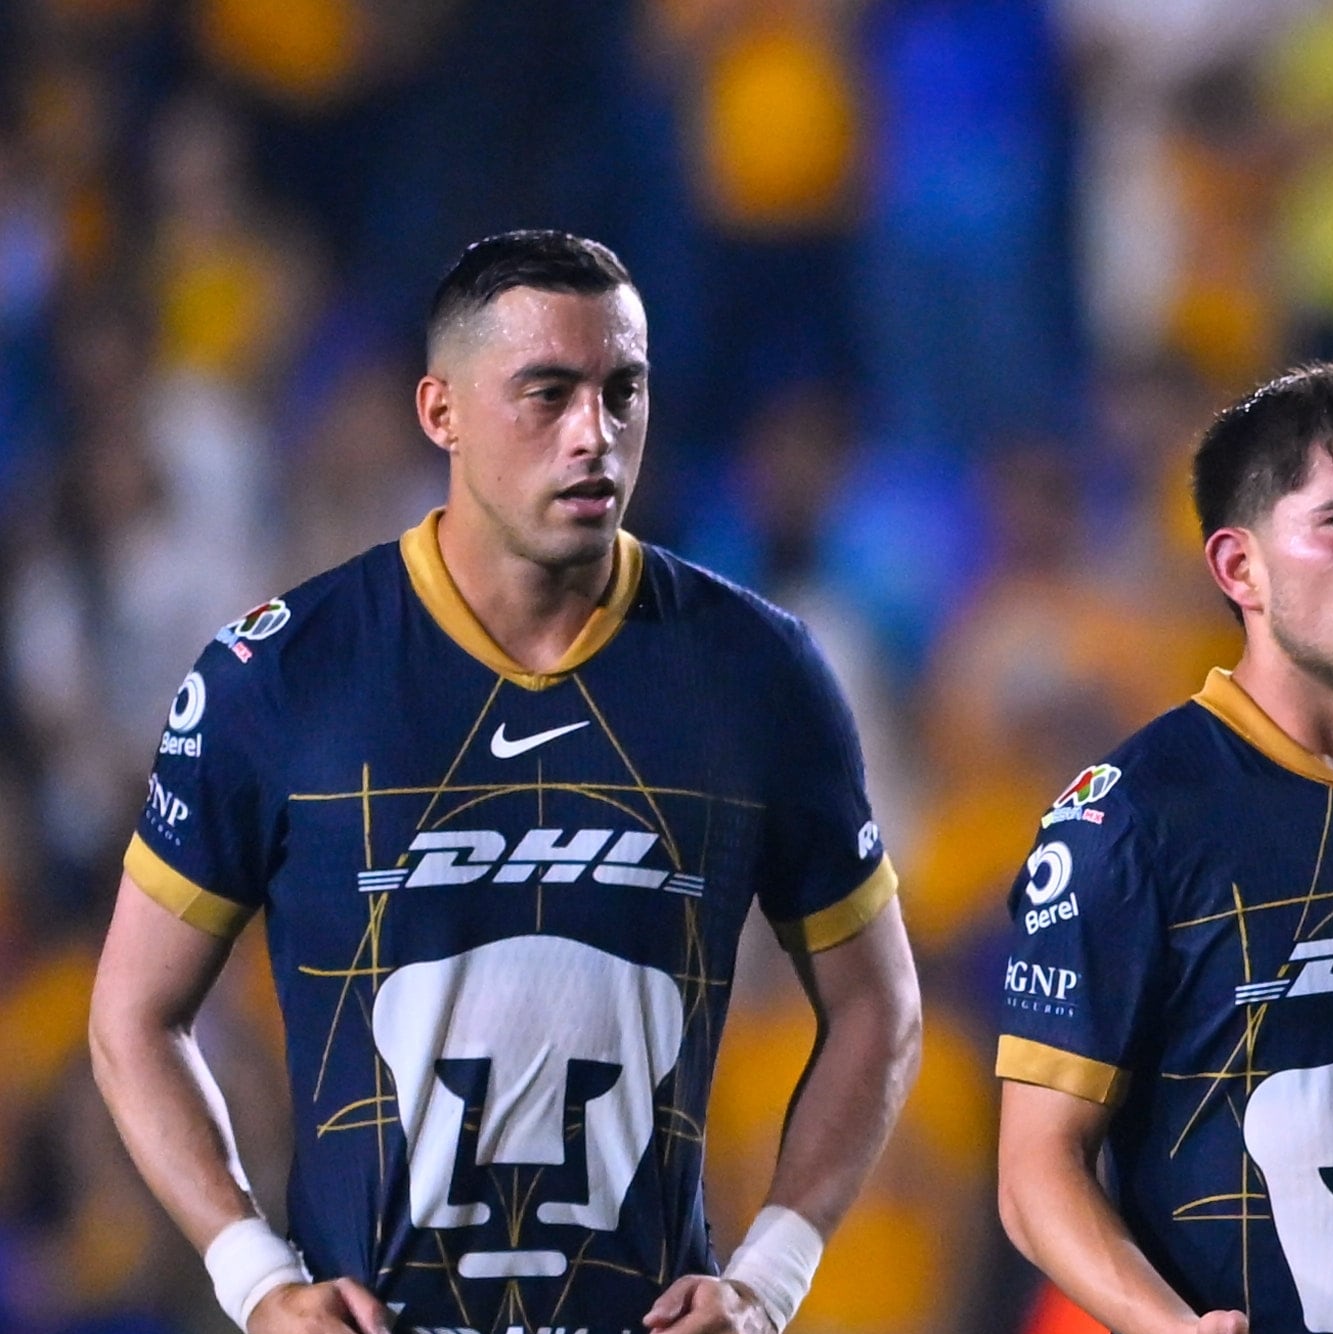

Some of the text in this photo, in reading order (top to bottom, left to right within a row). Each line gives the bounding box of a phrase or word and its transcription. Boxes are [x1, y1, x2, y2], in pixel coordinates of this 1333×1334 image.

[160, 730, 202, 758] Berel
[404, 828, 670, 888] DHL
[1025, 892, 1080, 935] Berel
[1010, 960, 1078, 1001] GNP
